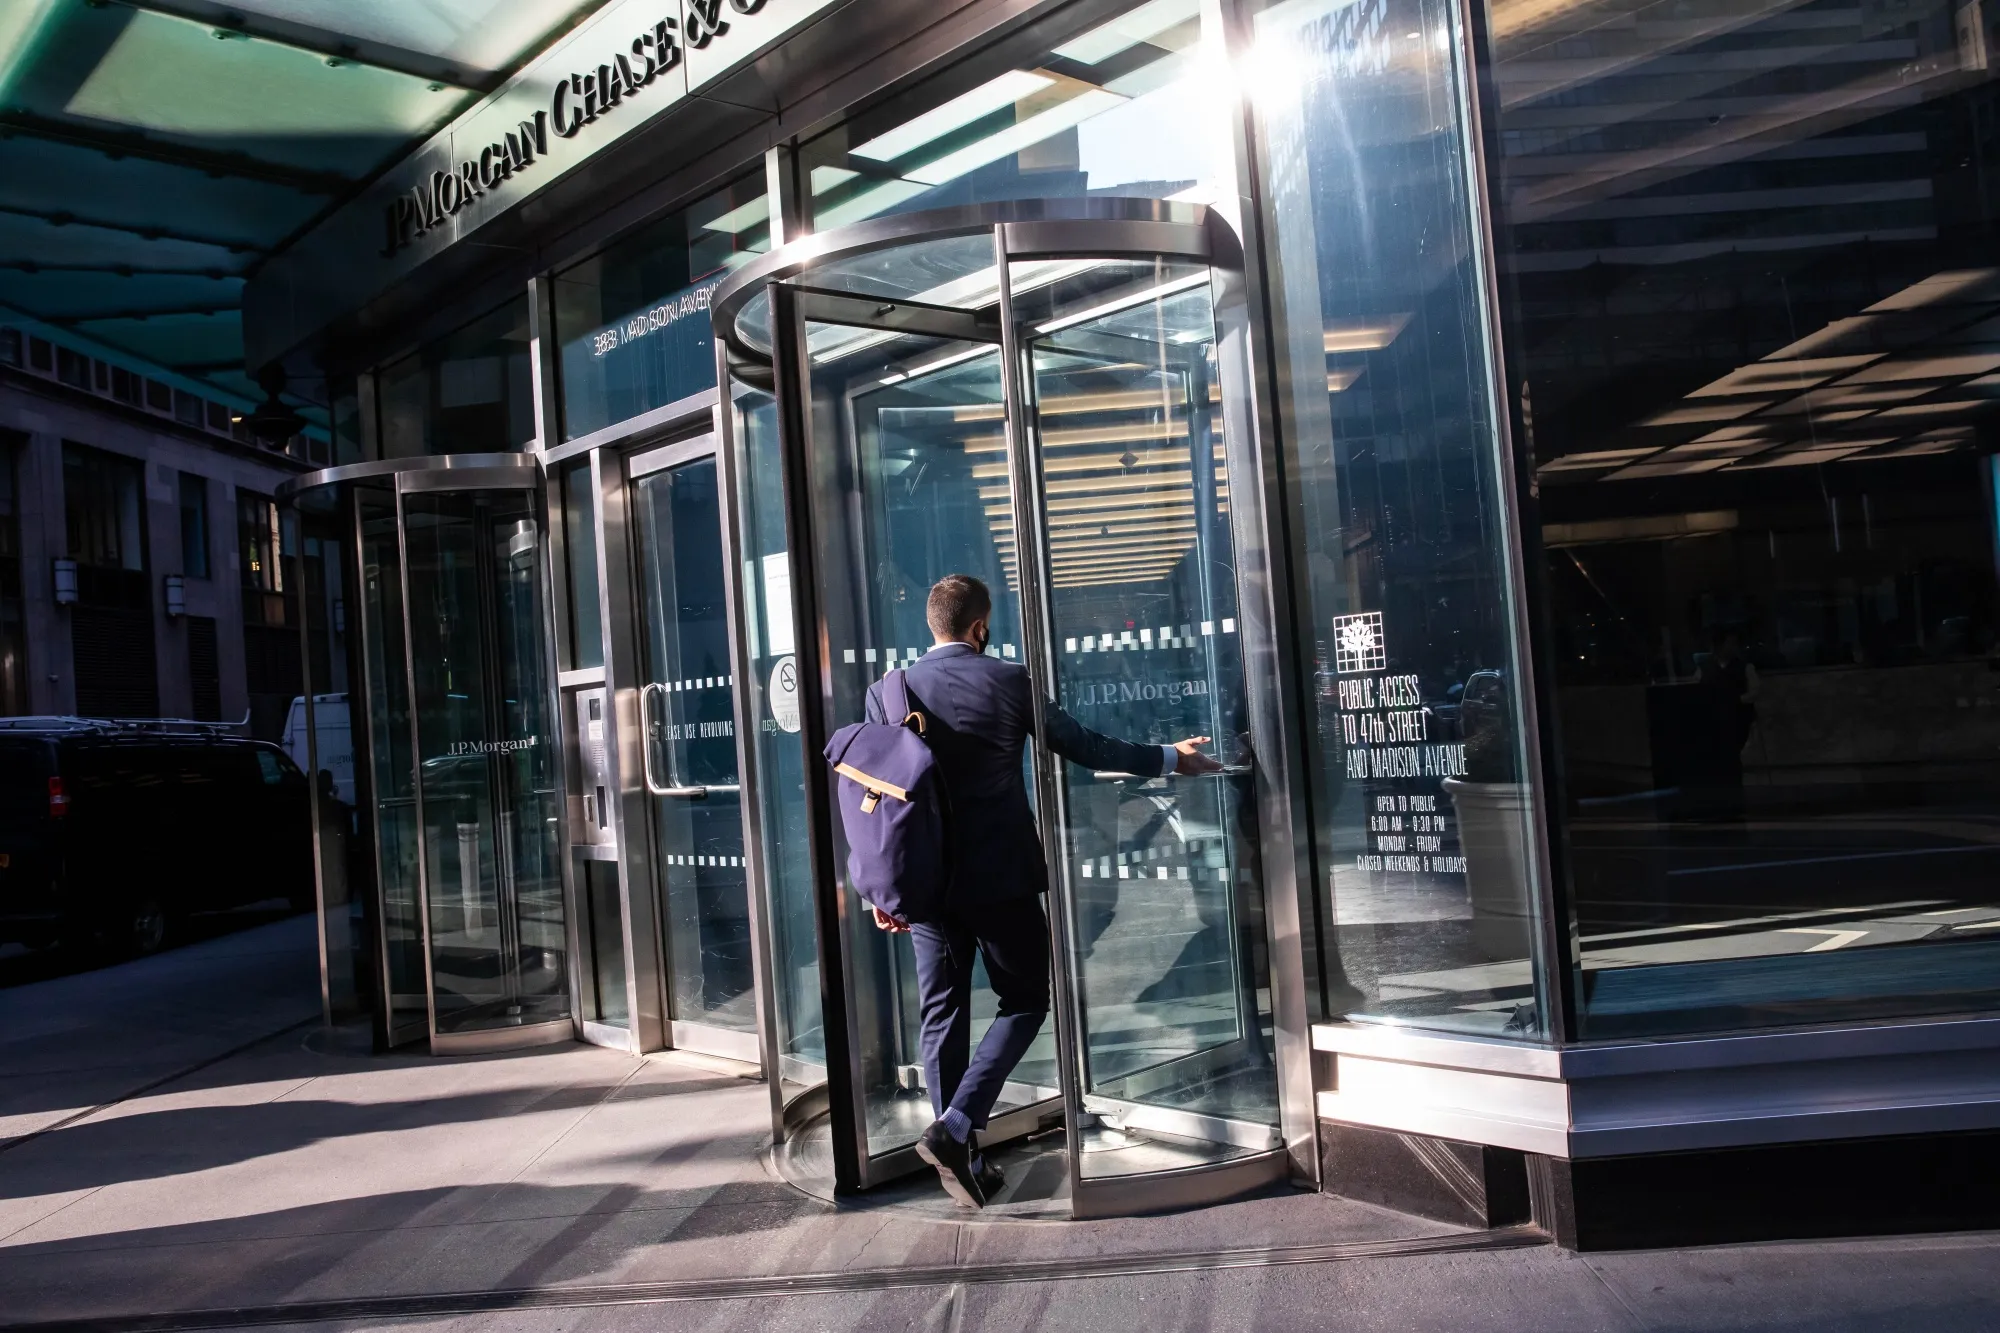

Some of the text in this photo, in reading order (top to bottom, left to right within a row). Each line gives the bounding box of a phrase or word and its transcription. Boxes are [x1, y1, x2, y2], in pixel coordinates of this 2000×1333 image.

[550, 17, 680, 138] CHASE
[1339, 674, 1420, 710] PUBLIC ACCESS
[684, 723, 697, 739] USE
[700, 720, 733, 738] REVOLVING
[1342, 710, 1427, 745] TO 47th STREET
[1347, 744, 1469, 778] AND MADISON AVENUE
[1377, 795, 1436, 812] OPEN TO PUBLIC
[1371, 815, 1388, 832] 6:00
[1391, 815, 1403, 832] AM
[1412, 815, 1430, 832] 9:30
[1434, 815, 1446, 832] PM
[1377, 835, 1406, 852] MONDAY
[1416, 835, 1441, 852] FRIDAY
[1357, 855, 1467, 873] CLOSED WEEKENDS & HOLIDAYS
